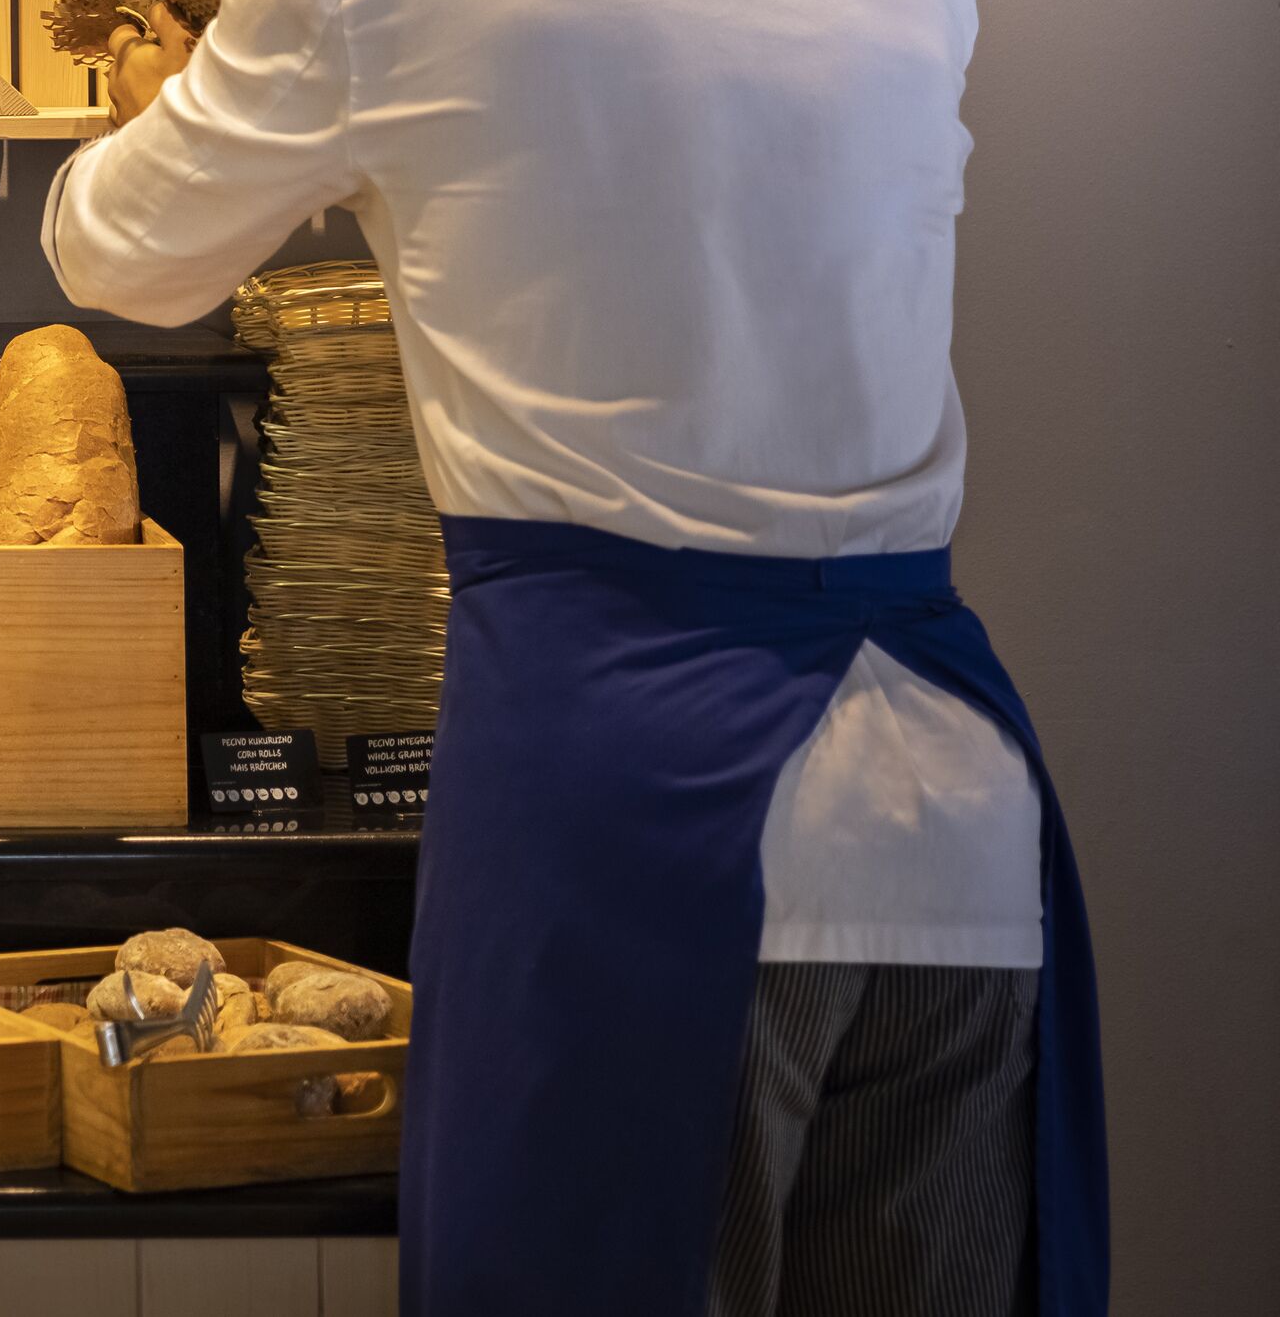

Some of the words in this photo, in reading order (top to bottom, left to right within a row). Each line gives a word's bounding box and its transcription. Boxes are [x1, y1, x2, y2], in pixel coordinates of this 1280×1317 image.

[248, 736, 292, 745] KUKURUZNO
[368, 738, 395, 748] PECIVO
[238, 750, 256, 759] CORN
[259, 749, 281, 758] ROLLS
[368, 752, 396, 761] WHOLE
[398, 751, 423, 760] GRAIN
[230, 763, 248, 772] MAIS
[250, 761, 287, 772] BRÖTCHEN
[365, 765, 406, 774] VOLLKORN
